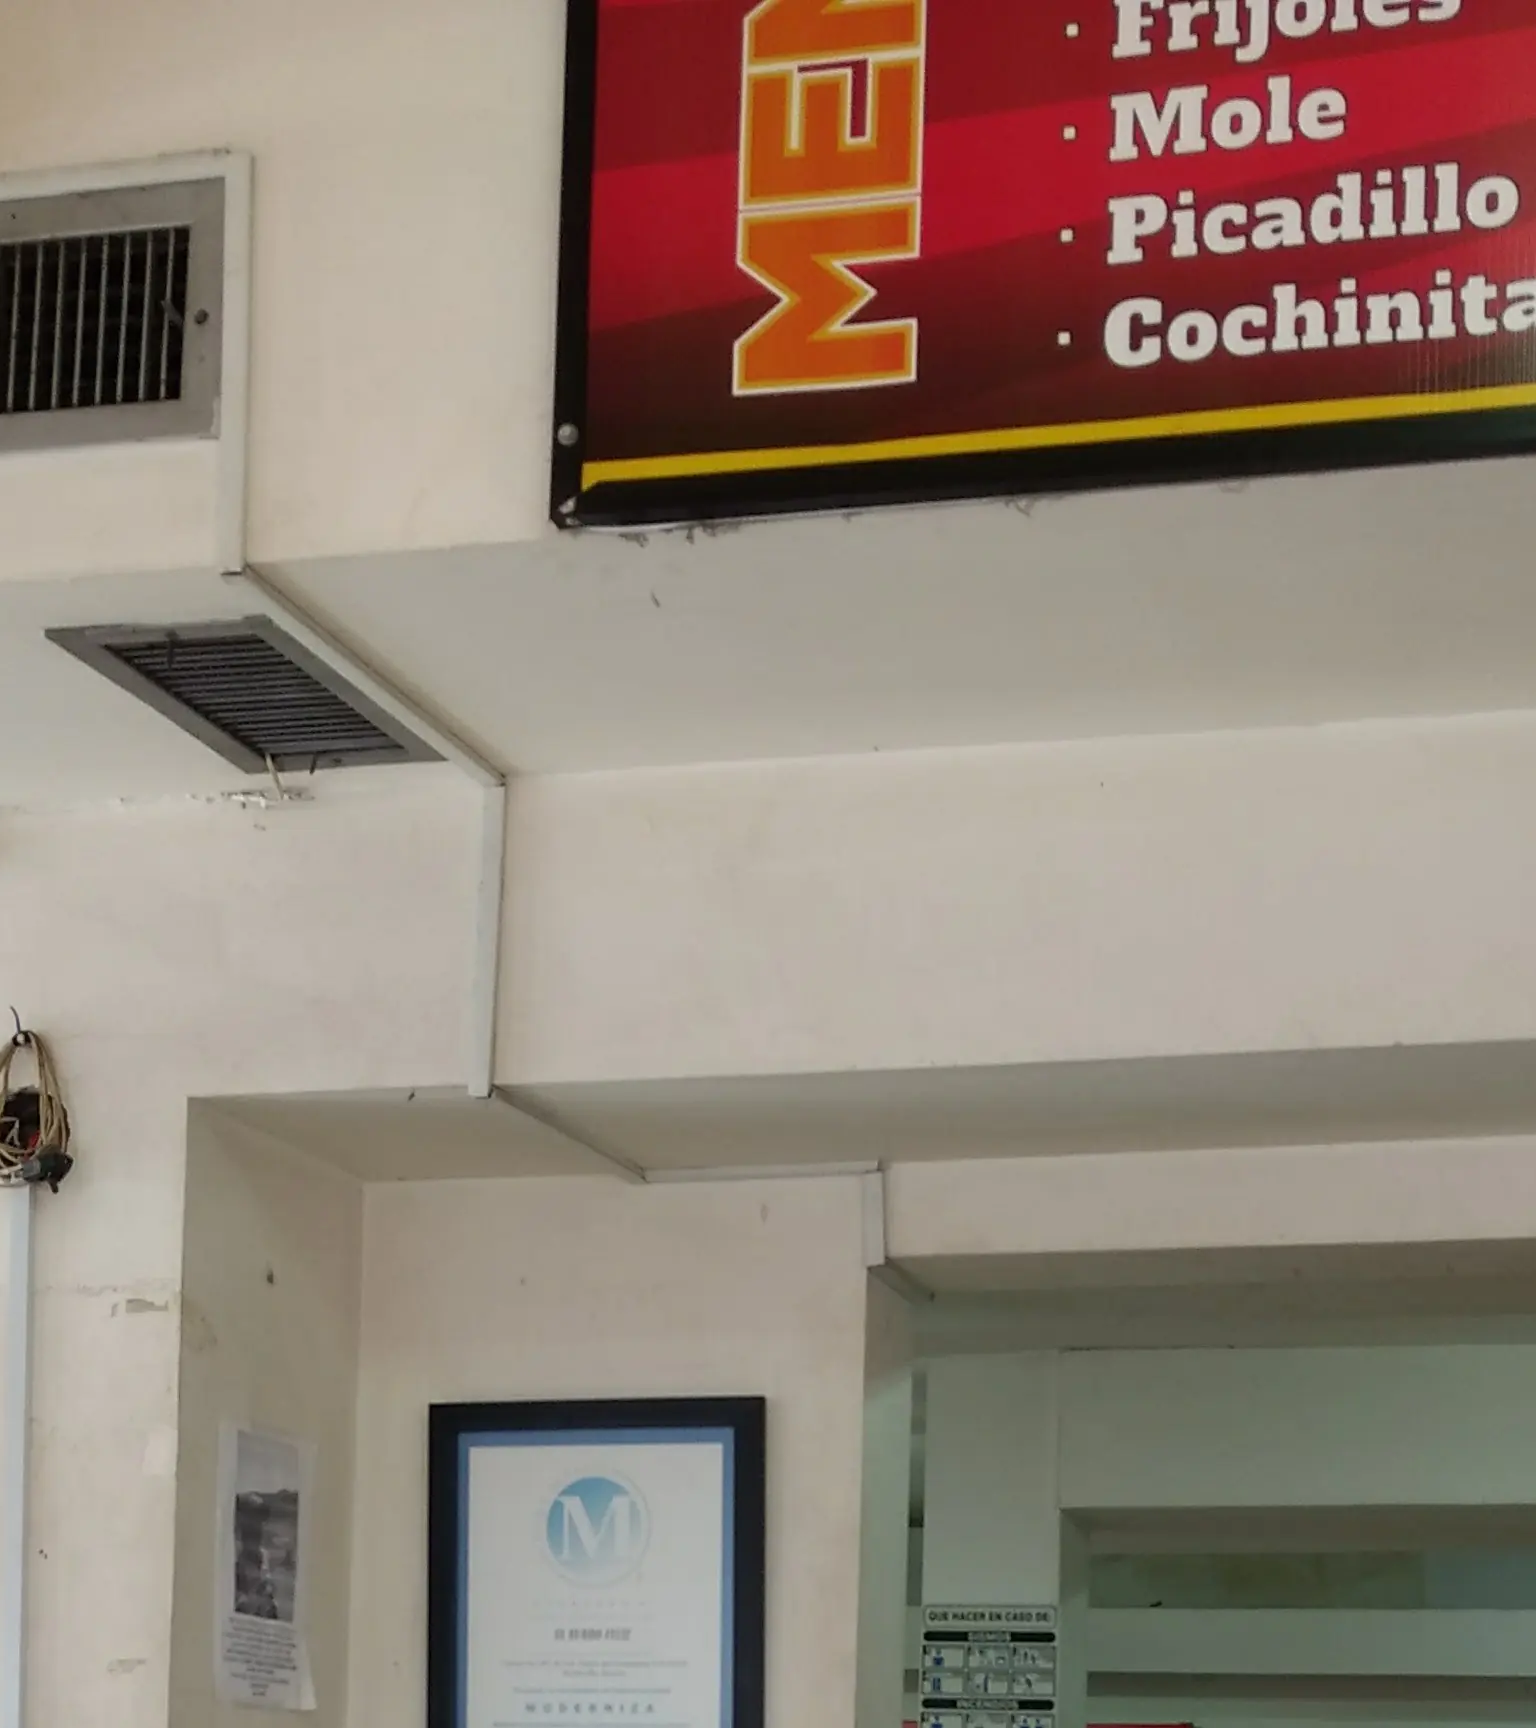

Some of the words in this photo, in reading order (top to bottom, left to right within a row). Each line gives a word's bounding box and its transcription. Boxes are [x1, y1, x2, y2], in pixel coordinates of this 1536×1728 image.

[1108, 75, 1348, 162] Mole
[1107, 162, 1520, 265] Picadillo
[557, 1495, 634, 1562] M
[952, 1611, 986, 1622] HACER
[989, 1611, 1003, 1622] EN
[1005, 1611, 1033, 1622] CASO
